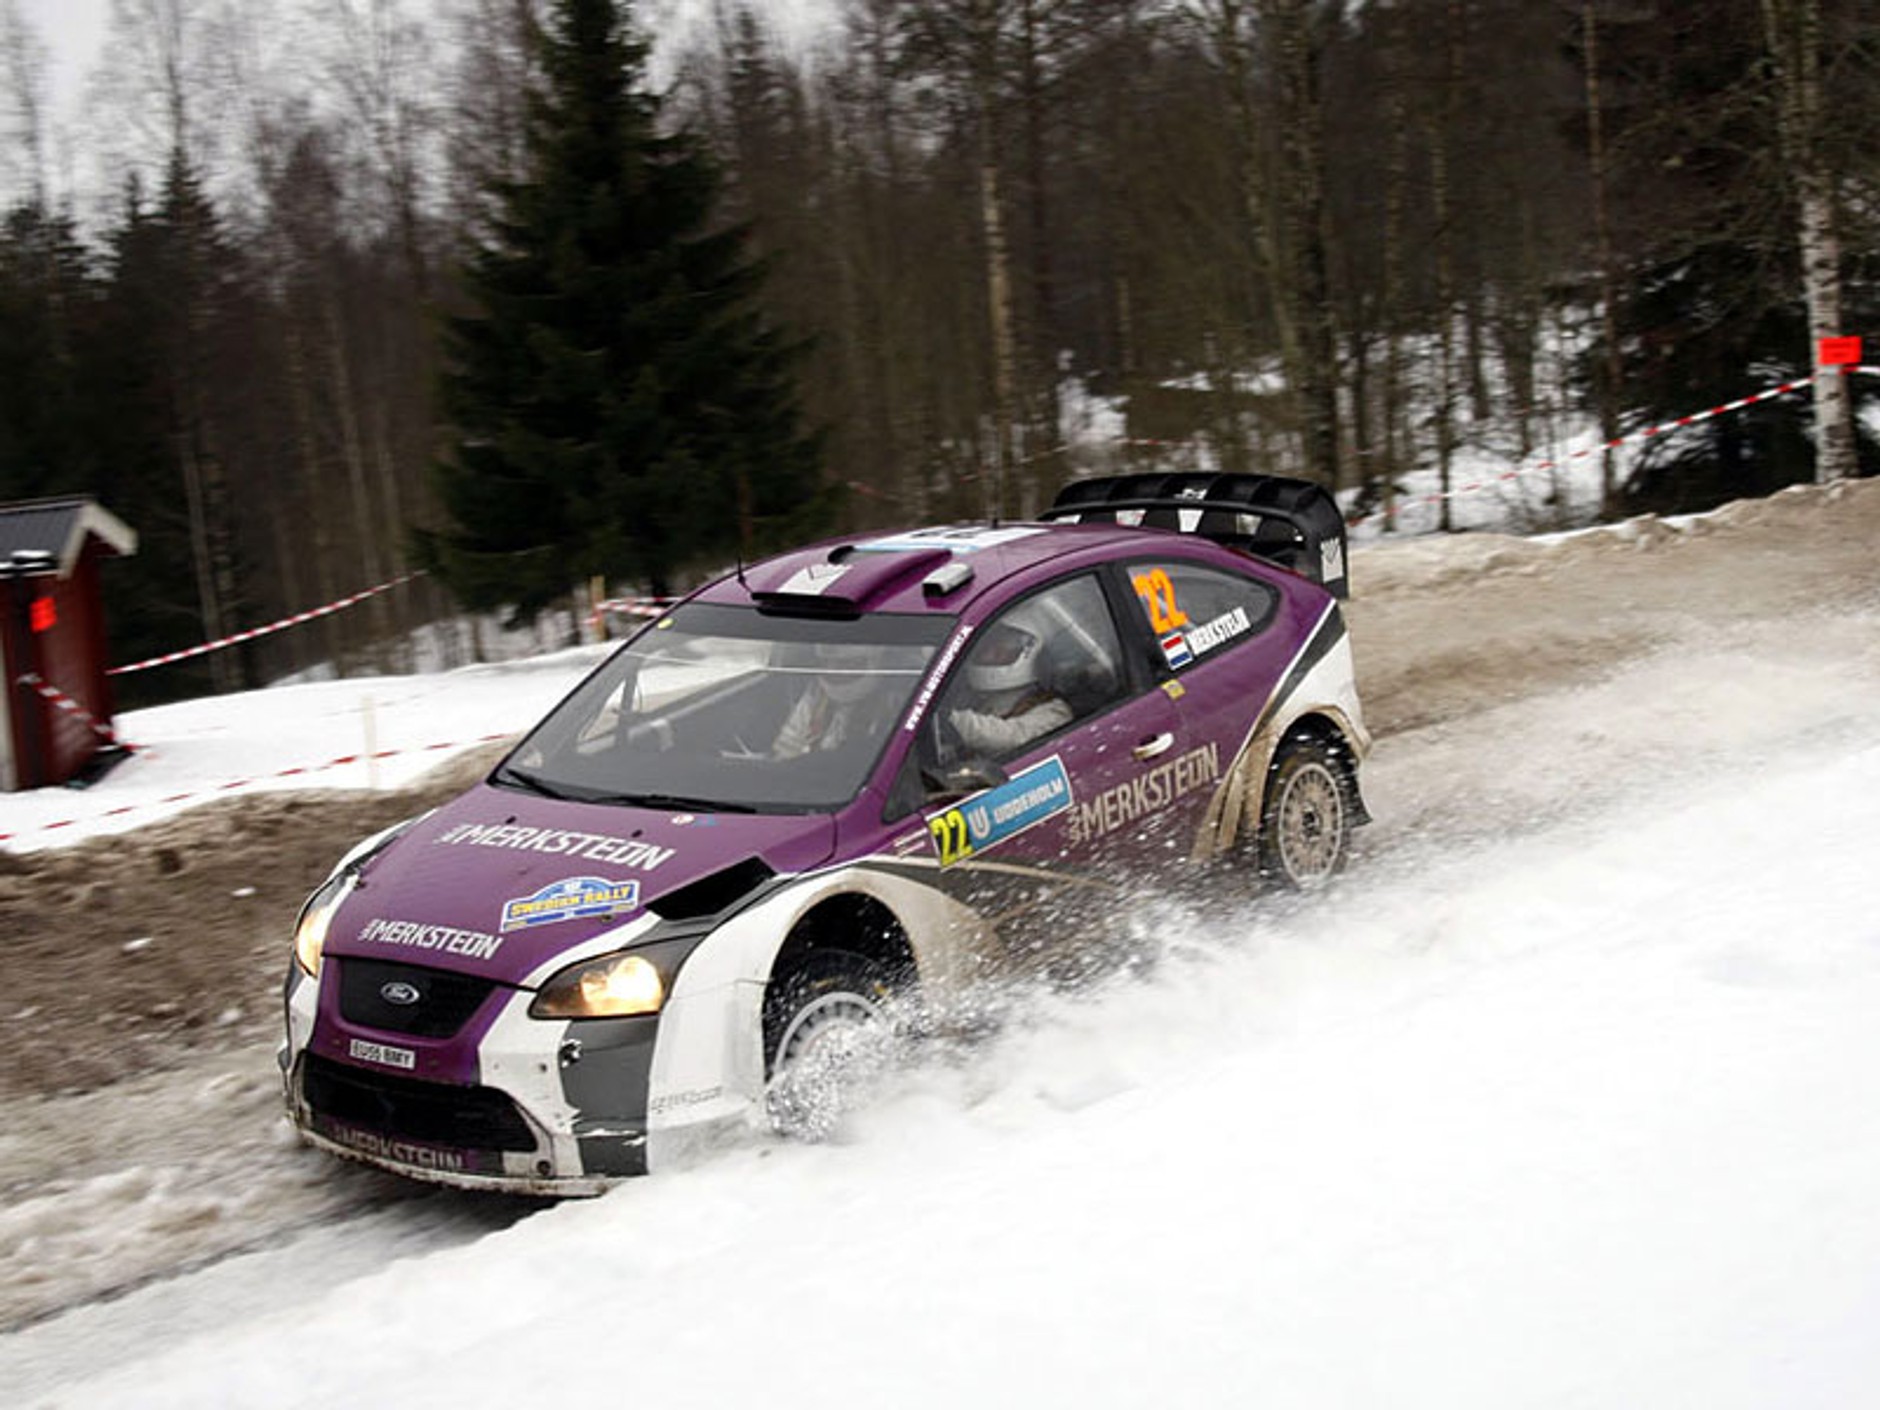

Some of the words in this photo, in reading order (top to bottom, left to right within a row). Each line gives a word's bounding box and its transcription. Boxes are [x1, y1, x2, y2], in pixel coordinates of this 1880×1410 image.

[1132, 568, 1188, 634] 22
[929, 810, 973, 869] 22
[581, 885, 631, 909] RALLY
